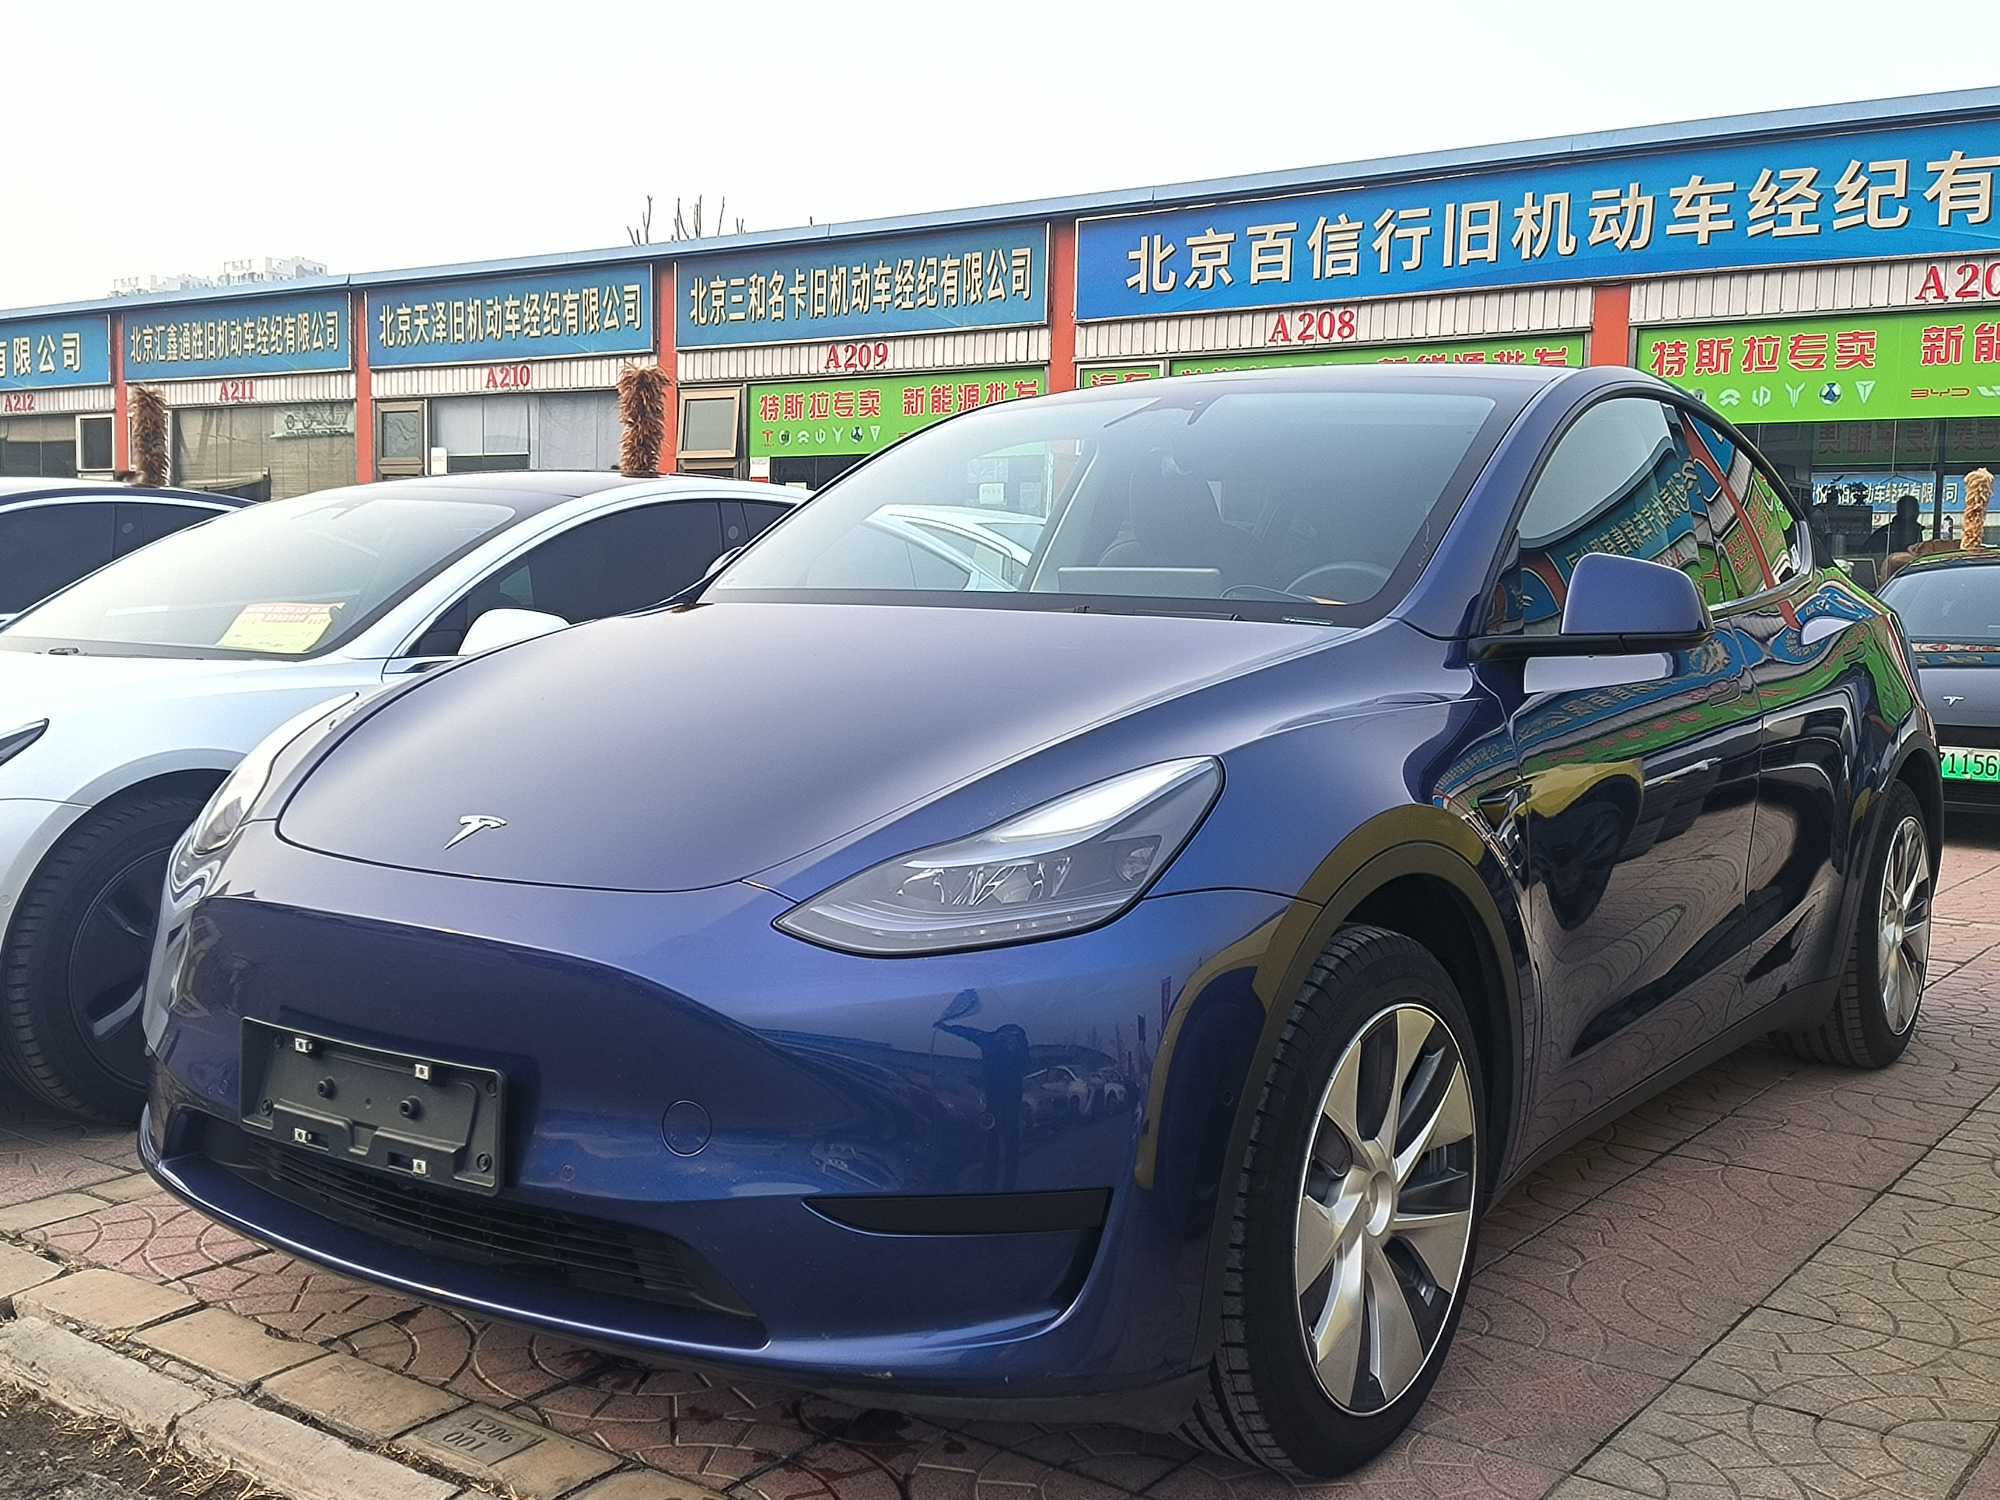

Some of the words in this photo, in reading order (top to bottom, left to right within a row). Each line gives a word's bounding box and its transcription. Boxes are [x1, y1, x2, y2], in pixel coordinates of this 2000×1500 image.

[689, 247, 1033, 326] 北京三和名卡旧机动车经纪有限公司
[378, 284, 642, 347] 北京天泽旧机动车经纪有限公司
[1268, 310, 1356, 343] A208
[130, 311, 339, 363] 北京汇鑫通胜旧机动车经纪有限公司
[1650, 329, 1878, 378] 特斯拉专卖
[823, 343, 889, 370] A209
[219, 381, 255, 401] A211
[485, 365, 531, 389] A210
[4, 393, 35, 412] A212
[760, 389, 881, 422] 特斯拉专卖
